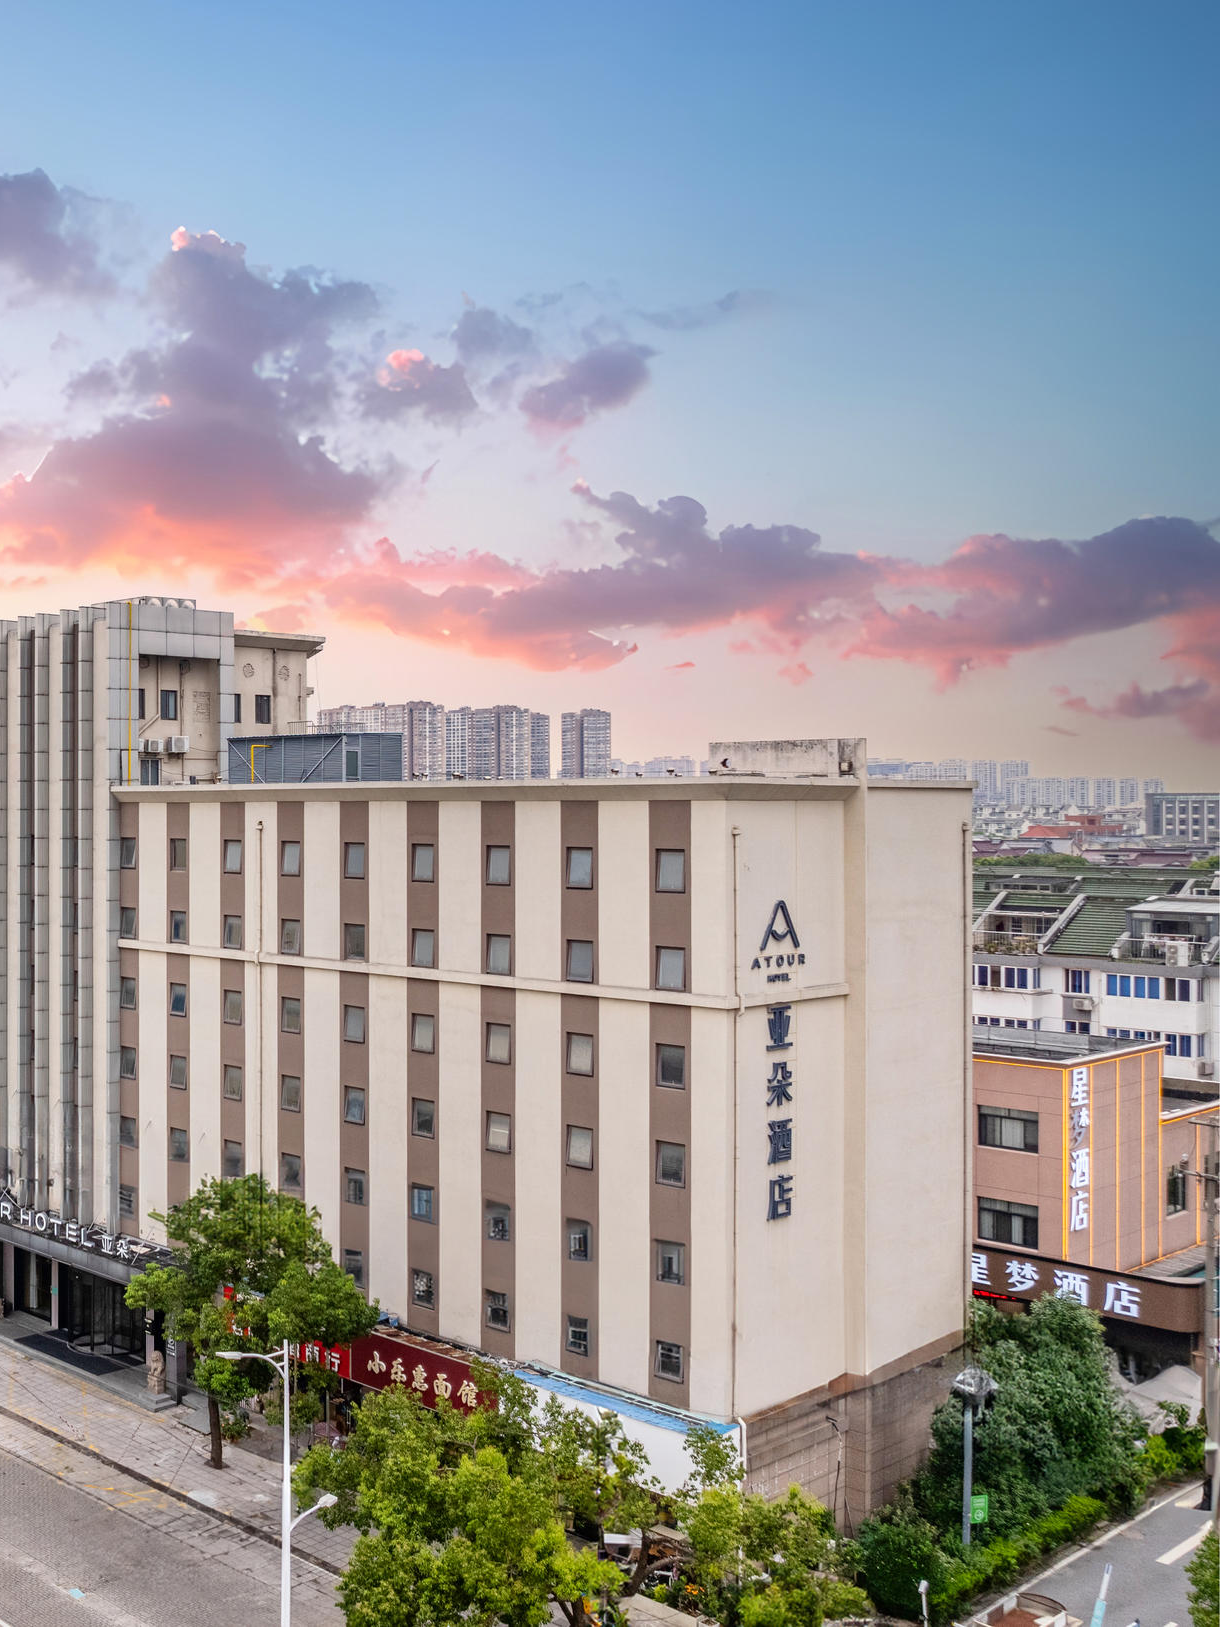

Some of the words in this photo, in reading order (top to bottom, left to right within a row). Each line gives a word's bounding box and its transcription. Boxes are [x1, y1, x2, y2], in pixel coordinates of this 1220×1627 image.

[751, 953, 806, 970] ATOUR
[766, 1004, 793, 1222] 亚朵酒店
[1070, 1067, 1090, 1232] 星梦酒店
[20, 1207, 96, 1248] HOTEL
[101, 1233, 131, 1260] 亚朵
